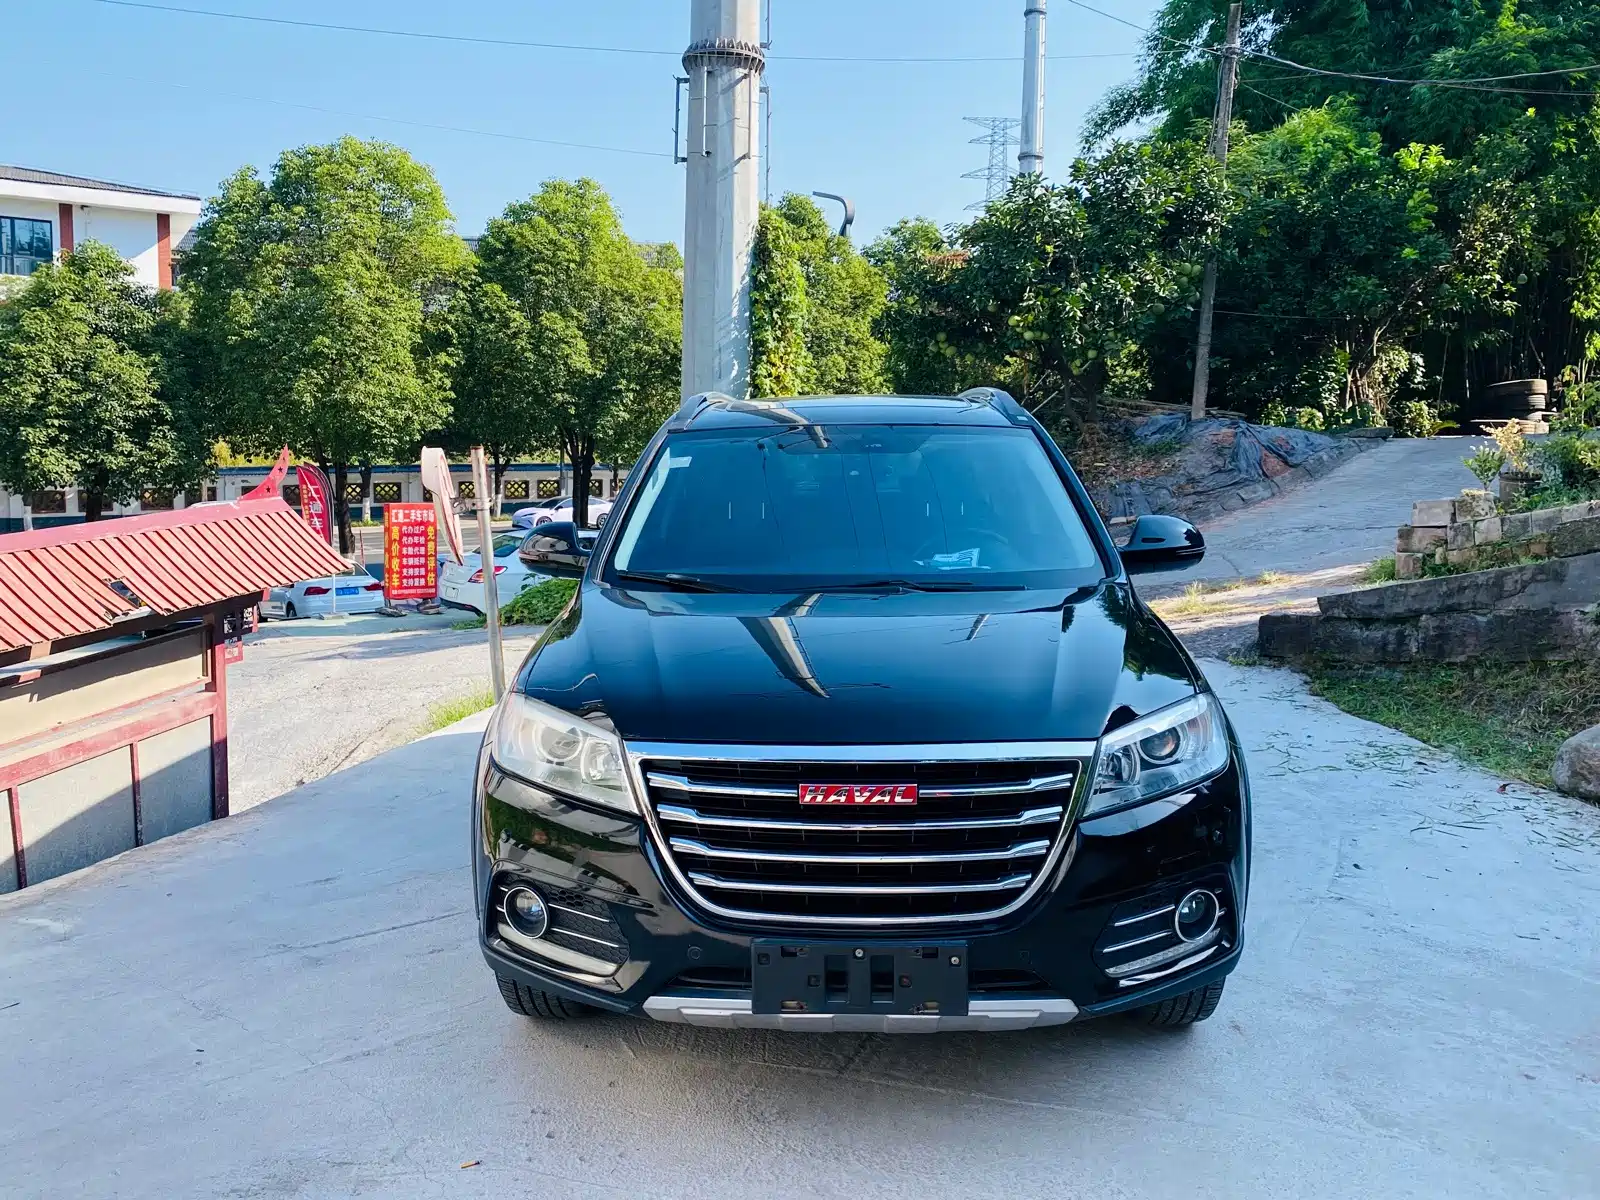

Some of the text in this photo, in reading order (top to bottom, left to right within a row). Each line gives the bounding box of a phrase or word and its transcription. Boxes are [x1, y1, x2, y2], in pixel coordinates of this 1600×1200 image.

[391, 510, 435, 523] 汇通二手车市场
[402, 525, 425, 534] 代办过户
[402, 536, 425, 545] 代办年检
[391, 526, 400, 587] 高价收车
[427, 526, 435, 586] 免费评估
[803, 786, 914, 803] HAVAL
